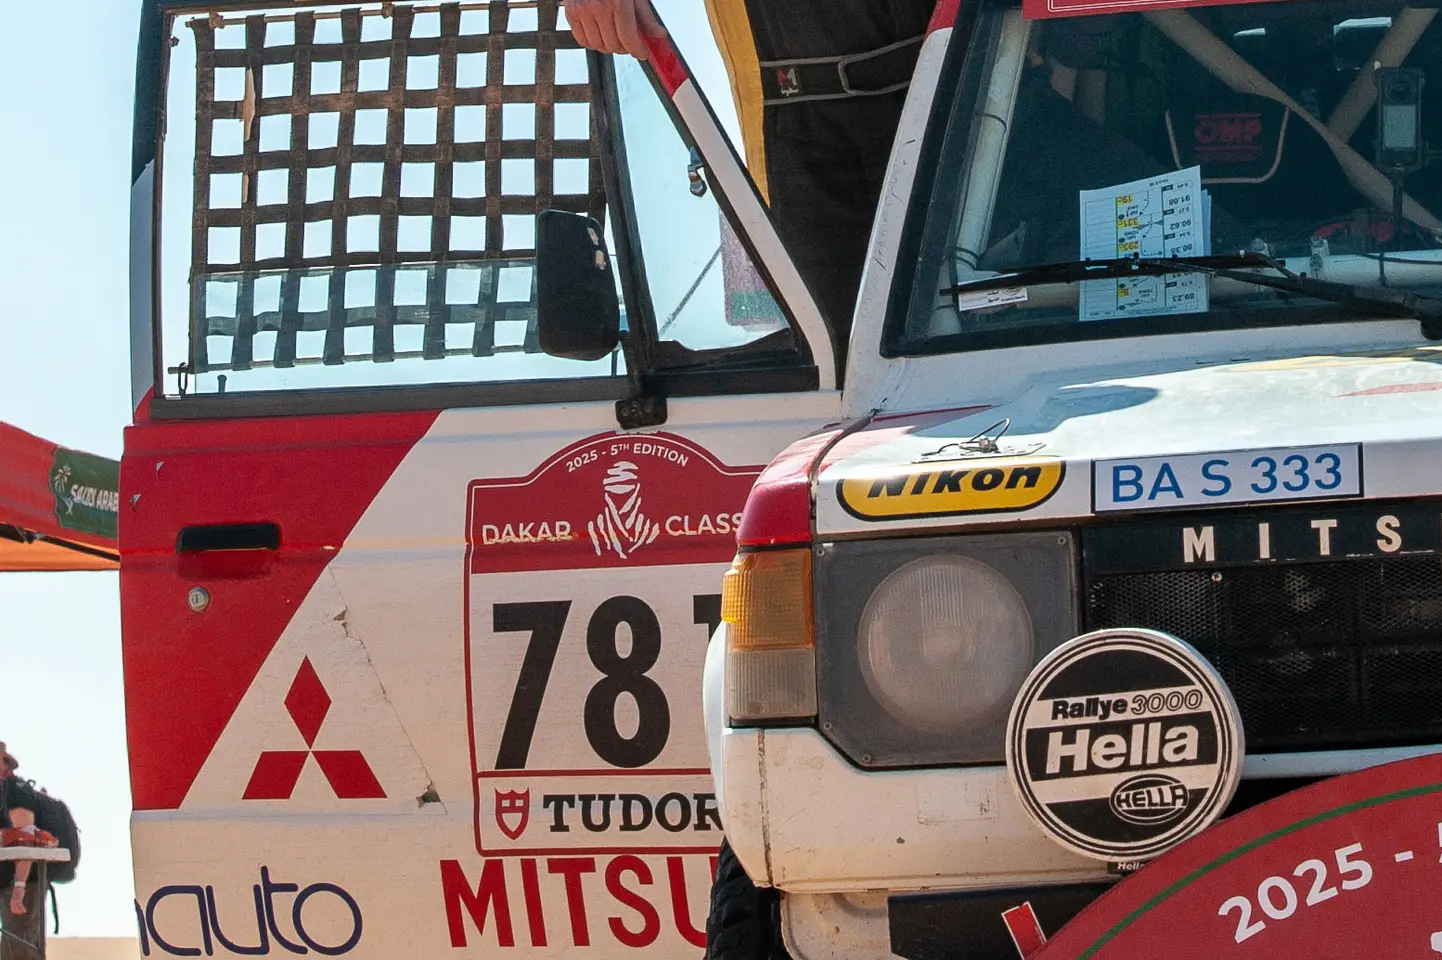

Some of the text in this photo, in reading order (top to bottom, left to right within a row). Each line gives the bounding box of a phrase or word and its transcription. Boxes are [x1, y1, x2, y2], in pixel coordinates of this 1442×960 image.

[566, 450, 598, 472] 2025
[610, 443, 630, 456] 5TH
[633, 443, 689, 467] EDITION
[866, 465, 1042, 498] Nikon
[1112, 452, 1342, 503] BA S 333
[71, 484, 97, 508] SAUDI
[482, 520, 573, 545] DAKAR
[492, 594, 722, 769] 78
[1051, 689, 1203, 720] Rallye 3000
[1045, 721, 1199, 774] Hella
[1116, 784, 1188, 808] HELLA
[1218, 843, 1375, 943] 2025
